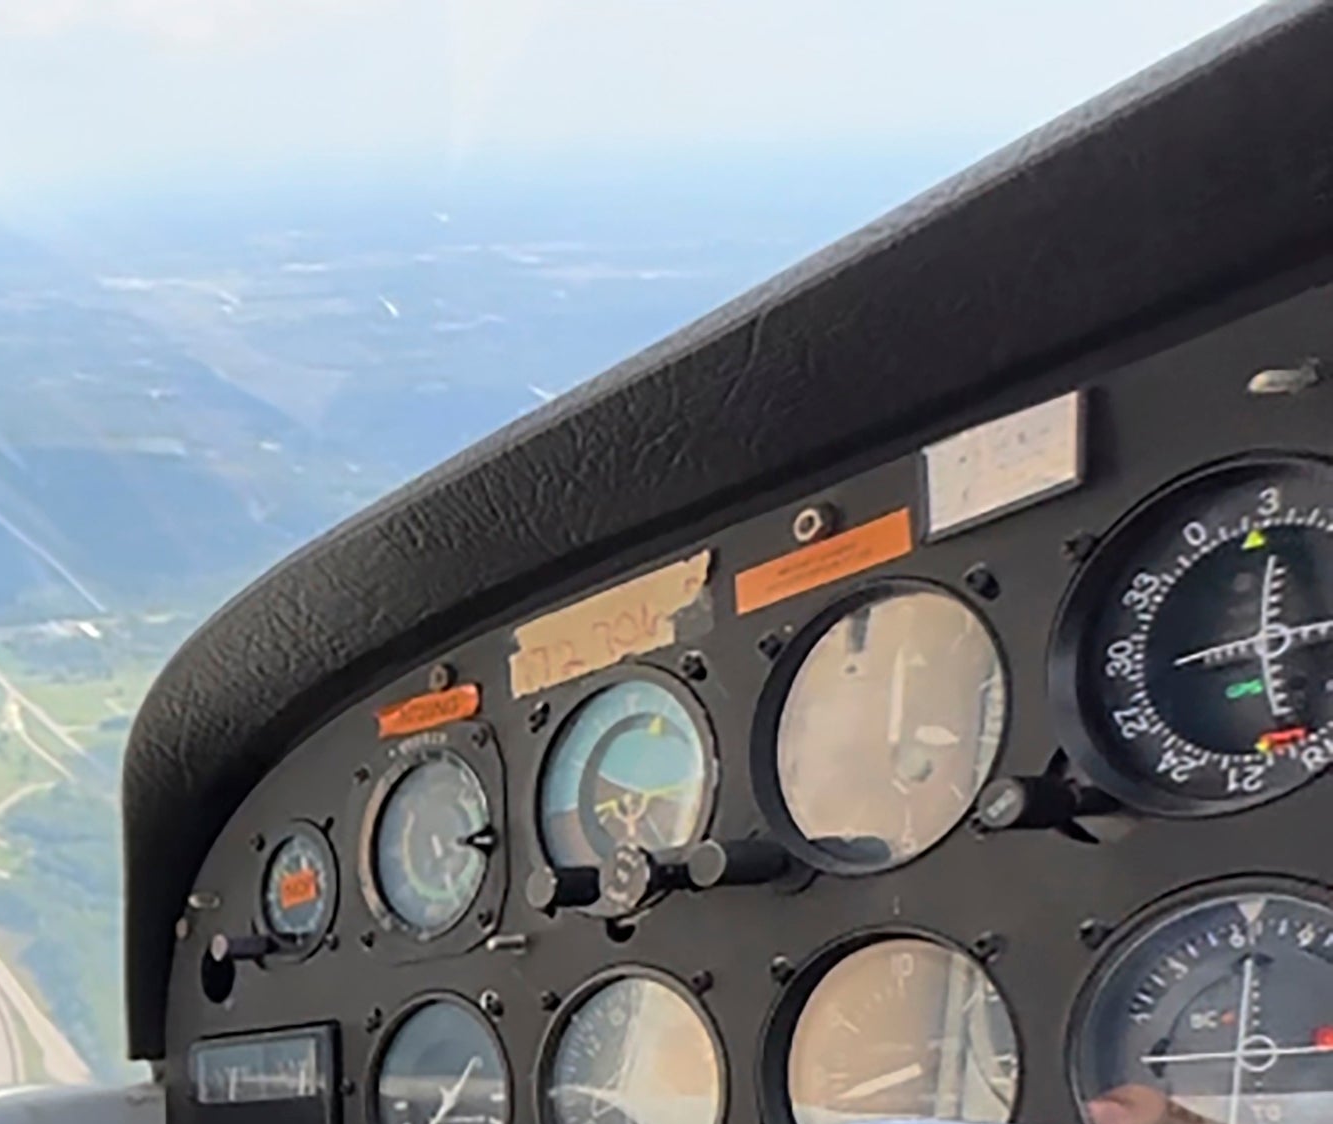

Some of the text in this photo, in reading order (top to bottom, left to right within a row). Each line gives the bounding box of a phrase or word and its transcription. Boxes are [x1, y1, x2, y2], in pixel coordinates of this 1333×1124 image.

[1257, 487, 1280, 516] 3
[1183, 521, 1207, 547] 0
[1122, 572, 1160, 611] 33
[1105, 640, 1135, 677] 30
[1113, 706, 1149, 739] 27
[1156, 750, 1199, 783] 24
[1226, 764, 1265, 792] 21
